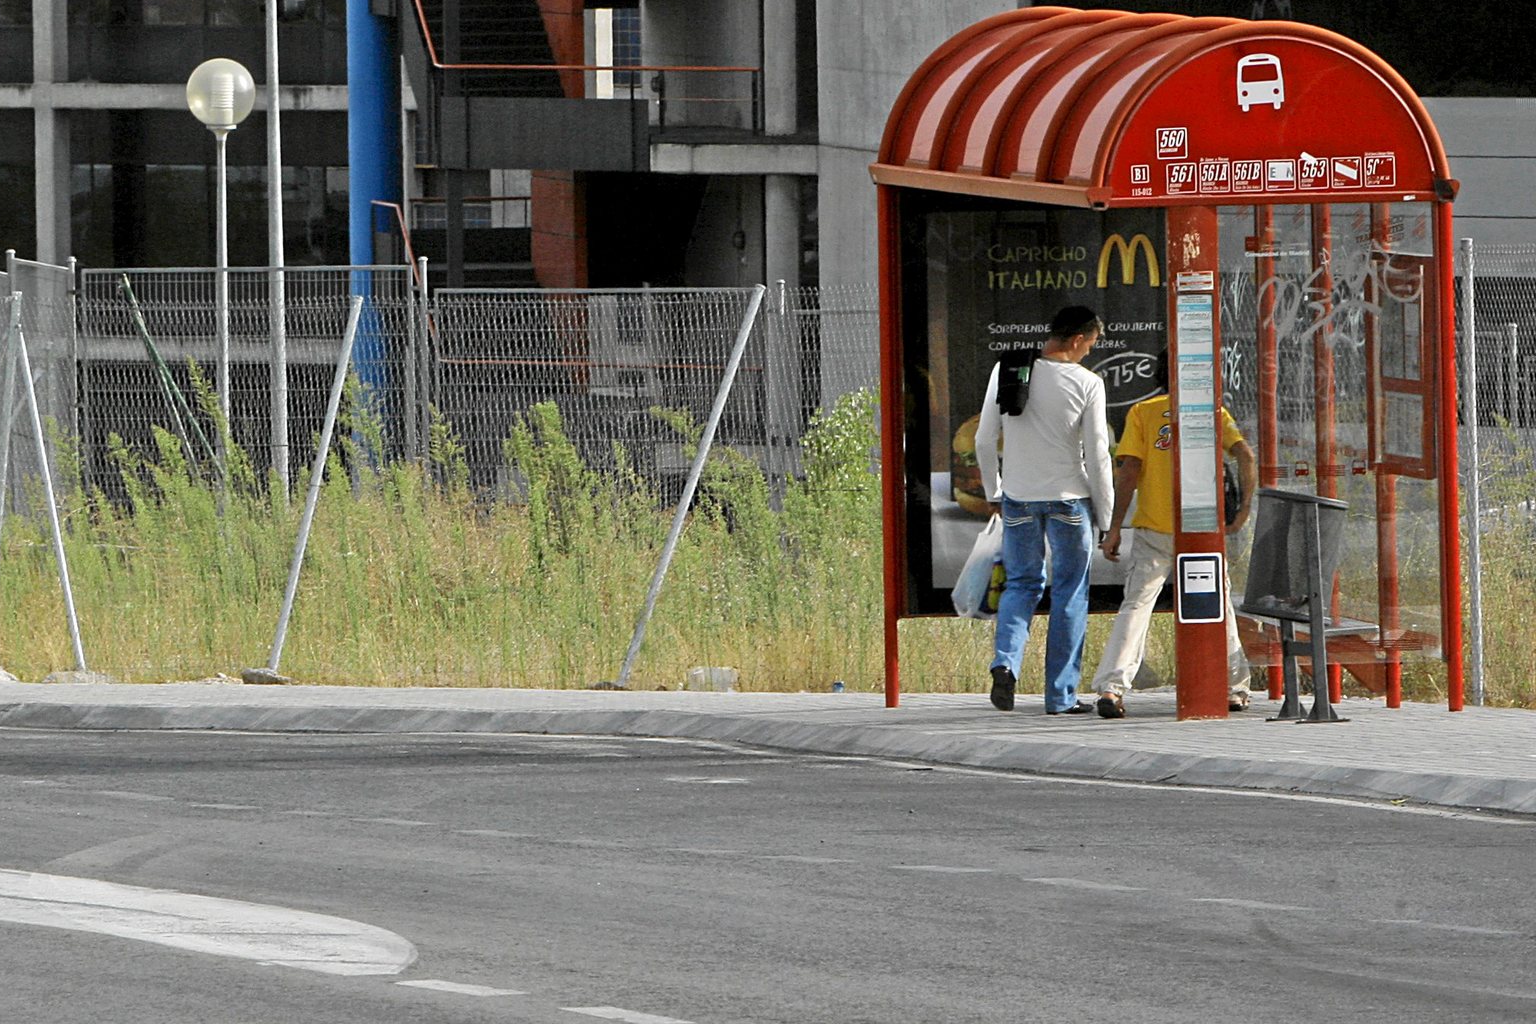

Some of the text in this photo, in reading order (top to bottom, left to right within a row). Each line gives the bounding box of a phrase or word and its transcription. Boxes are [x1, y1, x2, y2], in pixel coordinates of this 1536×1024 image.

[1160, 130, 1184, 147] 560
[1134, 167, 1146, 181] B1
[1170, 165, 1193, 182] 561
[1201, 164, 1228, 181] 561A
[1234, 163, 1261, 180] 561B
[1302, 160, 1326, 178] 563
[987, 243, 1087, 263] CAPRICHO
[987, 270, 1087, 291] ITALIANO
[1107, 321, 1164, 332] CRUJIENTE
[988, 341, 1011, 351] CON
[1014, 341, 1034, 350] PAN
[1095, 339, 1127, 349] ERBAS
